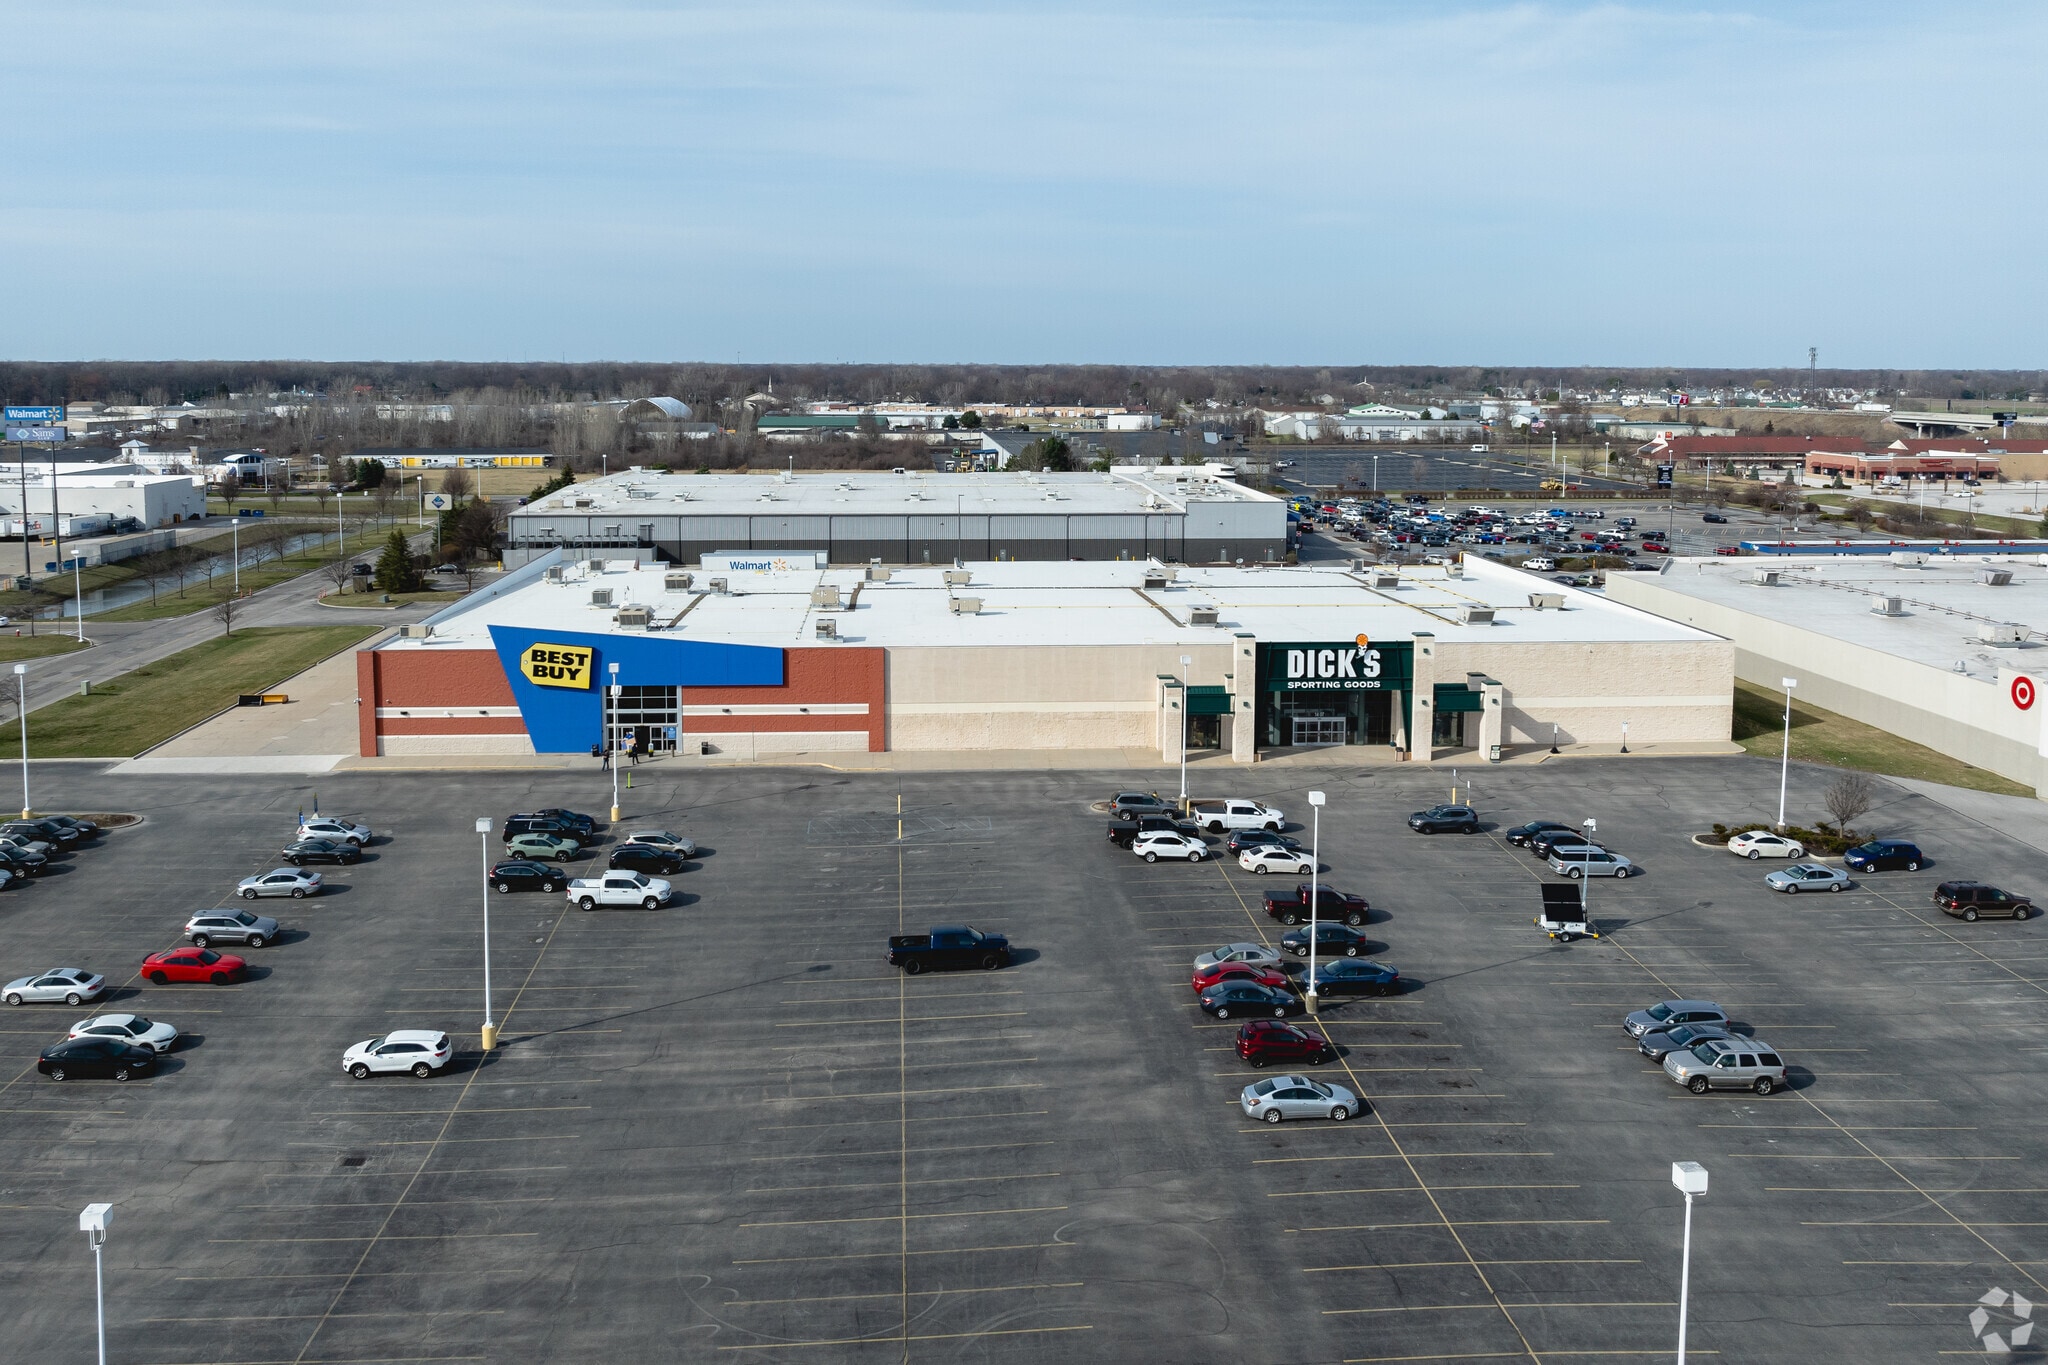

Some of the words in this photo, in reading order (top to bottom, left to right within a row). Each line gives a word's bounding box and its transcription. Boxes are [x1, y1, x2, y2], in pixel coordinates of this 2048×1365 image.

[8, 410, 47, 418] Walmart
[730, 561, 771, 570] Walmart
[531, 649, 588, 666] BEST
[1287, 649, 1381, 678] DICK'S
[532, 664, 582, 680] BUY
[1287, 681, 1341, 689] SPORTING
